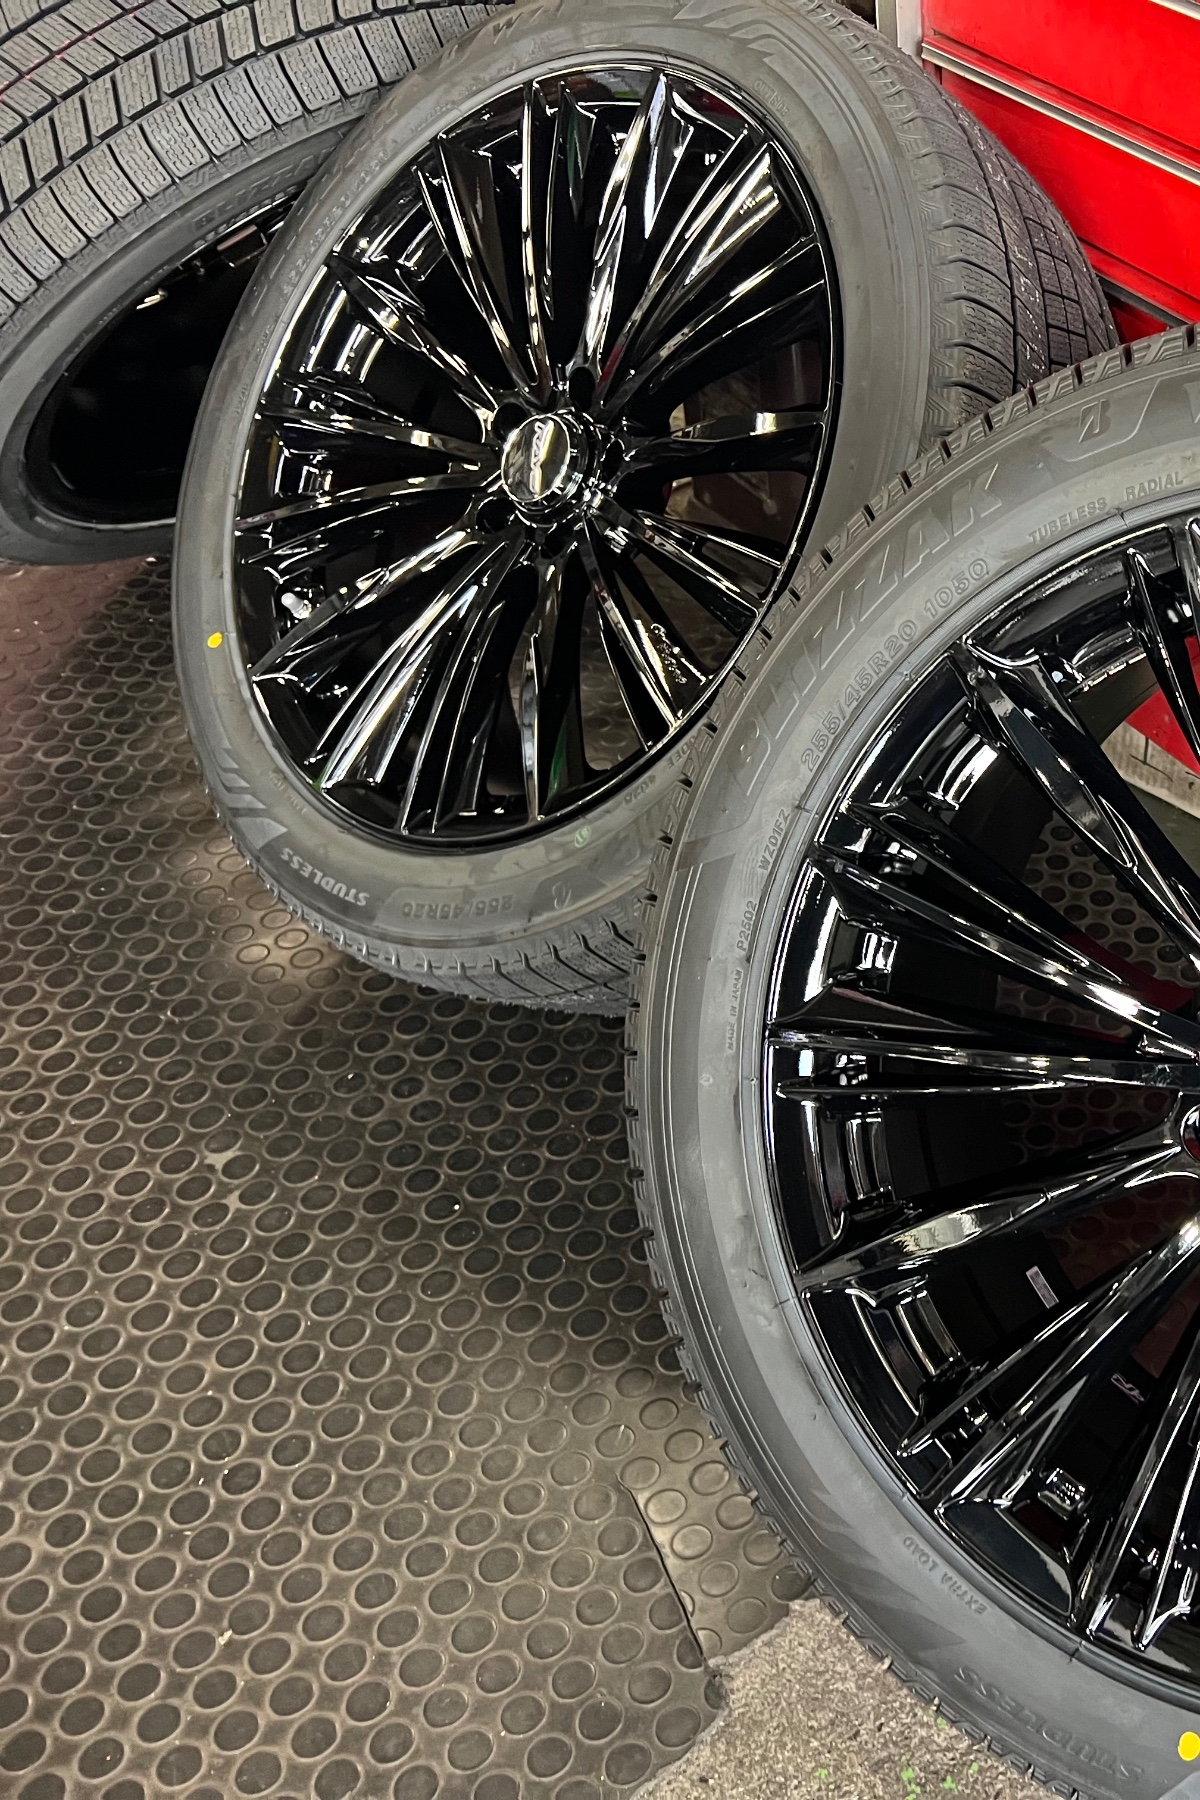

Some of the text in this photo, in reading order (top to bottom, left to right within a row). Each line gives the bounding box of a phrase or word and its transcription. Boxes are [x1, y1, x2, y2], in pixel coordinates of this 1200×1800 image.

[1028, 496, 1108, 546] TUBELESS
[1125, 472, 1184, 500] RADIAL
[800, 555, 992, 772] 255/45R20 105Q
[280, 847, 370, 907] STUDLESS
[732, 969, 743, 1001] JAPAN
[902, 1534, 988, 1616] EXTRA LOAD
[956, 1664, 1145, 1784] STUDLESS
